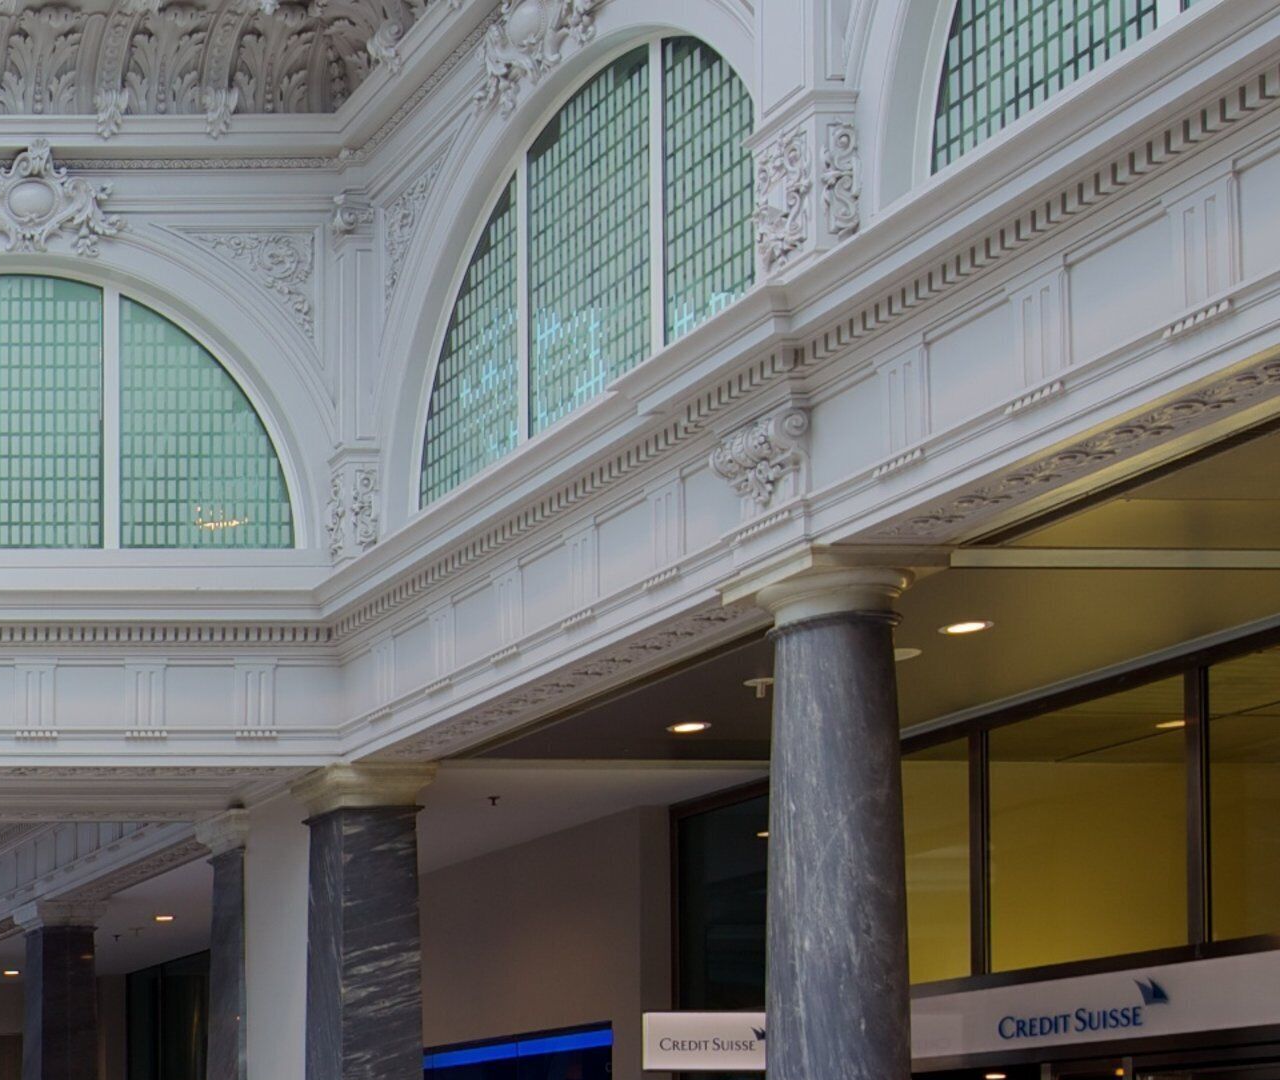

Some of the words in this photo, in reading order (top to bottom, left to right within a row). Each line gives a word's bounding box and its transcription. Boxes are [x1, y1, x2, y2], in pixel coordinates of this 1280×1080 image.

[998, 1014, 1071, 1039] CREDIT
[1075, 1006, 1142, 1032] SUISSE
[659, 1037, 709, 1051] CREDIT
[712, 1037, 756, 1051] SUISSE
